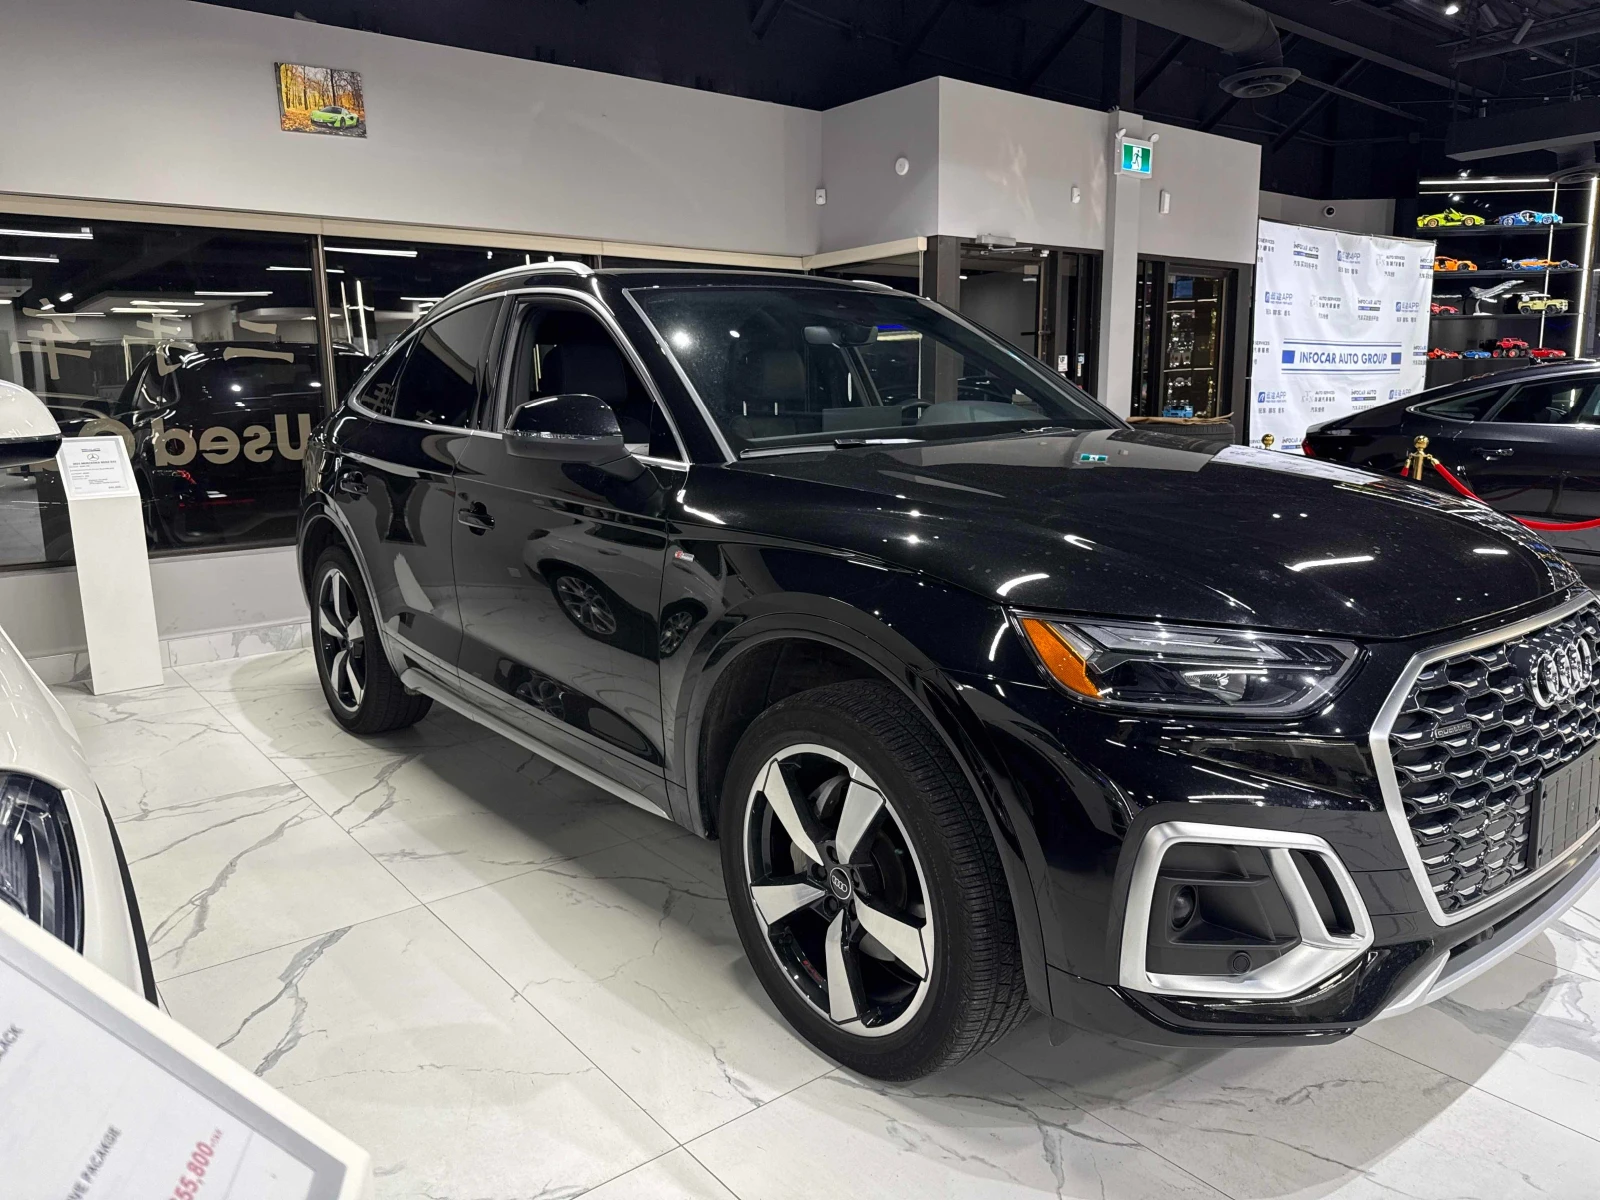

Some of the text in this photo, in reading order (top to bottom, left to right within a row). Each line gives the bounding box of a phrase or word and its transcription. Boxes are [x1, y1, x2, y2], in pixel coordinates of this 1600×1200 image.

[1299, 352, 1388, 365] INFOCAR AUTO GROUP
[167, 1141, 214, 1200] 55,800
